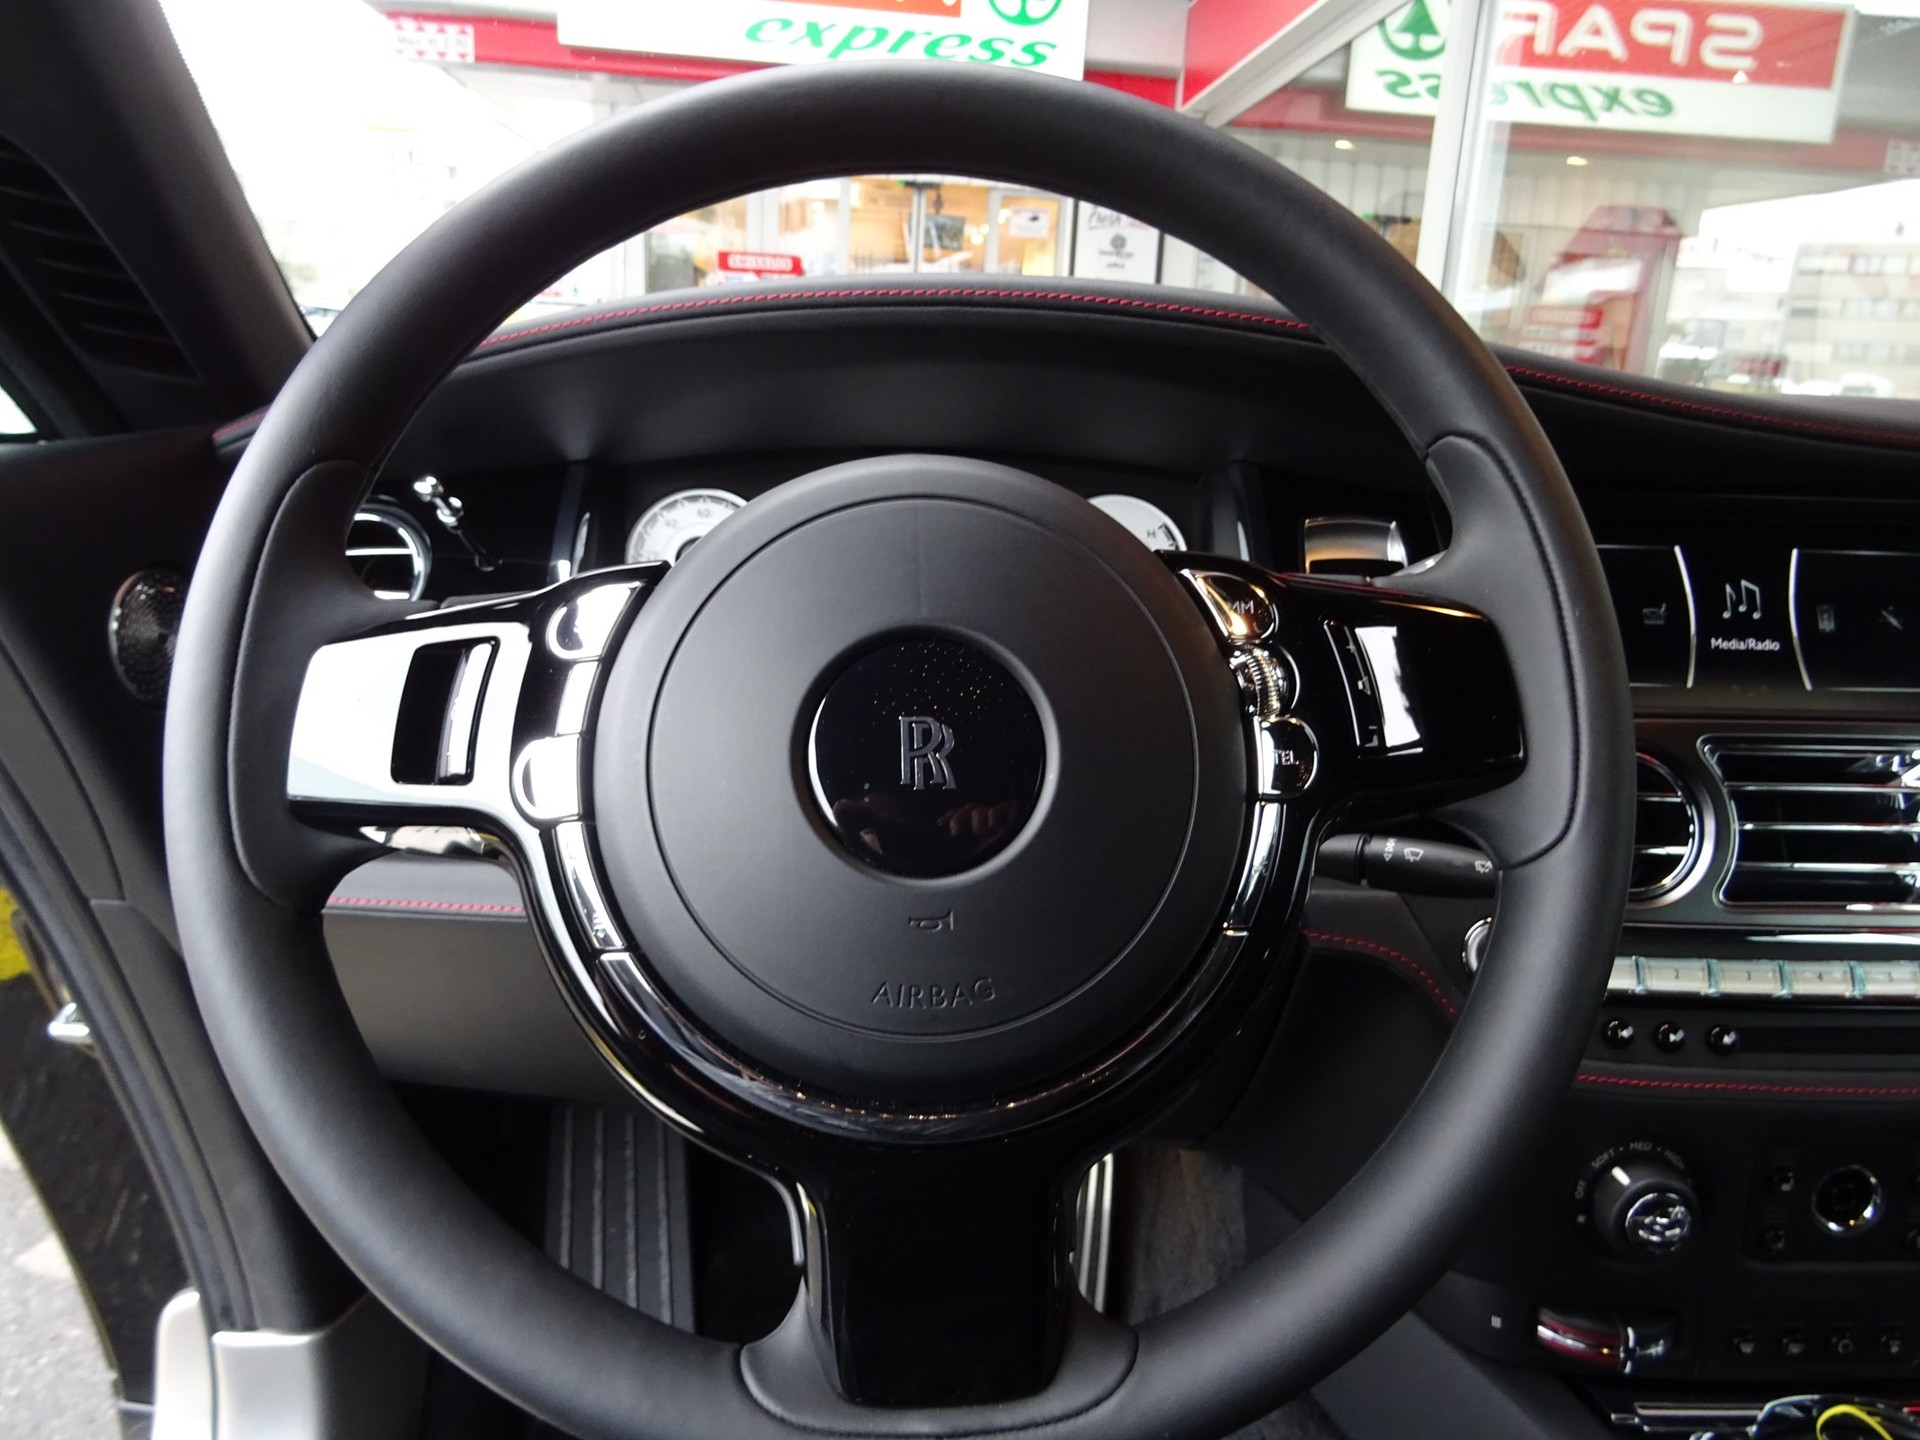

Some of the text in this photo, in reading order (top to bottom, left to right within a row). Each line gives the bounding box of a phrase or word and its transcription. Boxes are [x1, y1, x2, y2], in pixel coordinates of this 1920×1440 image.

[744, 17, 1058, 68] express
[1147, 529, 1156, 539] H
[1710, 636, 1780, 652] Media/Radio
[1273, 749, 1299, 766] TEL
[871, 978, 996, 1009] AIRBAG
